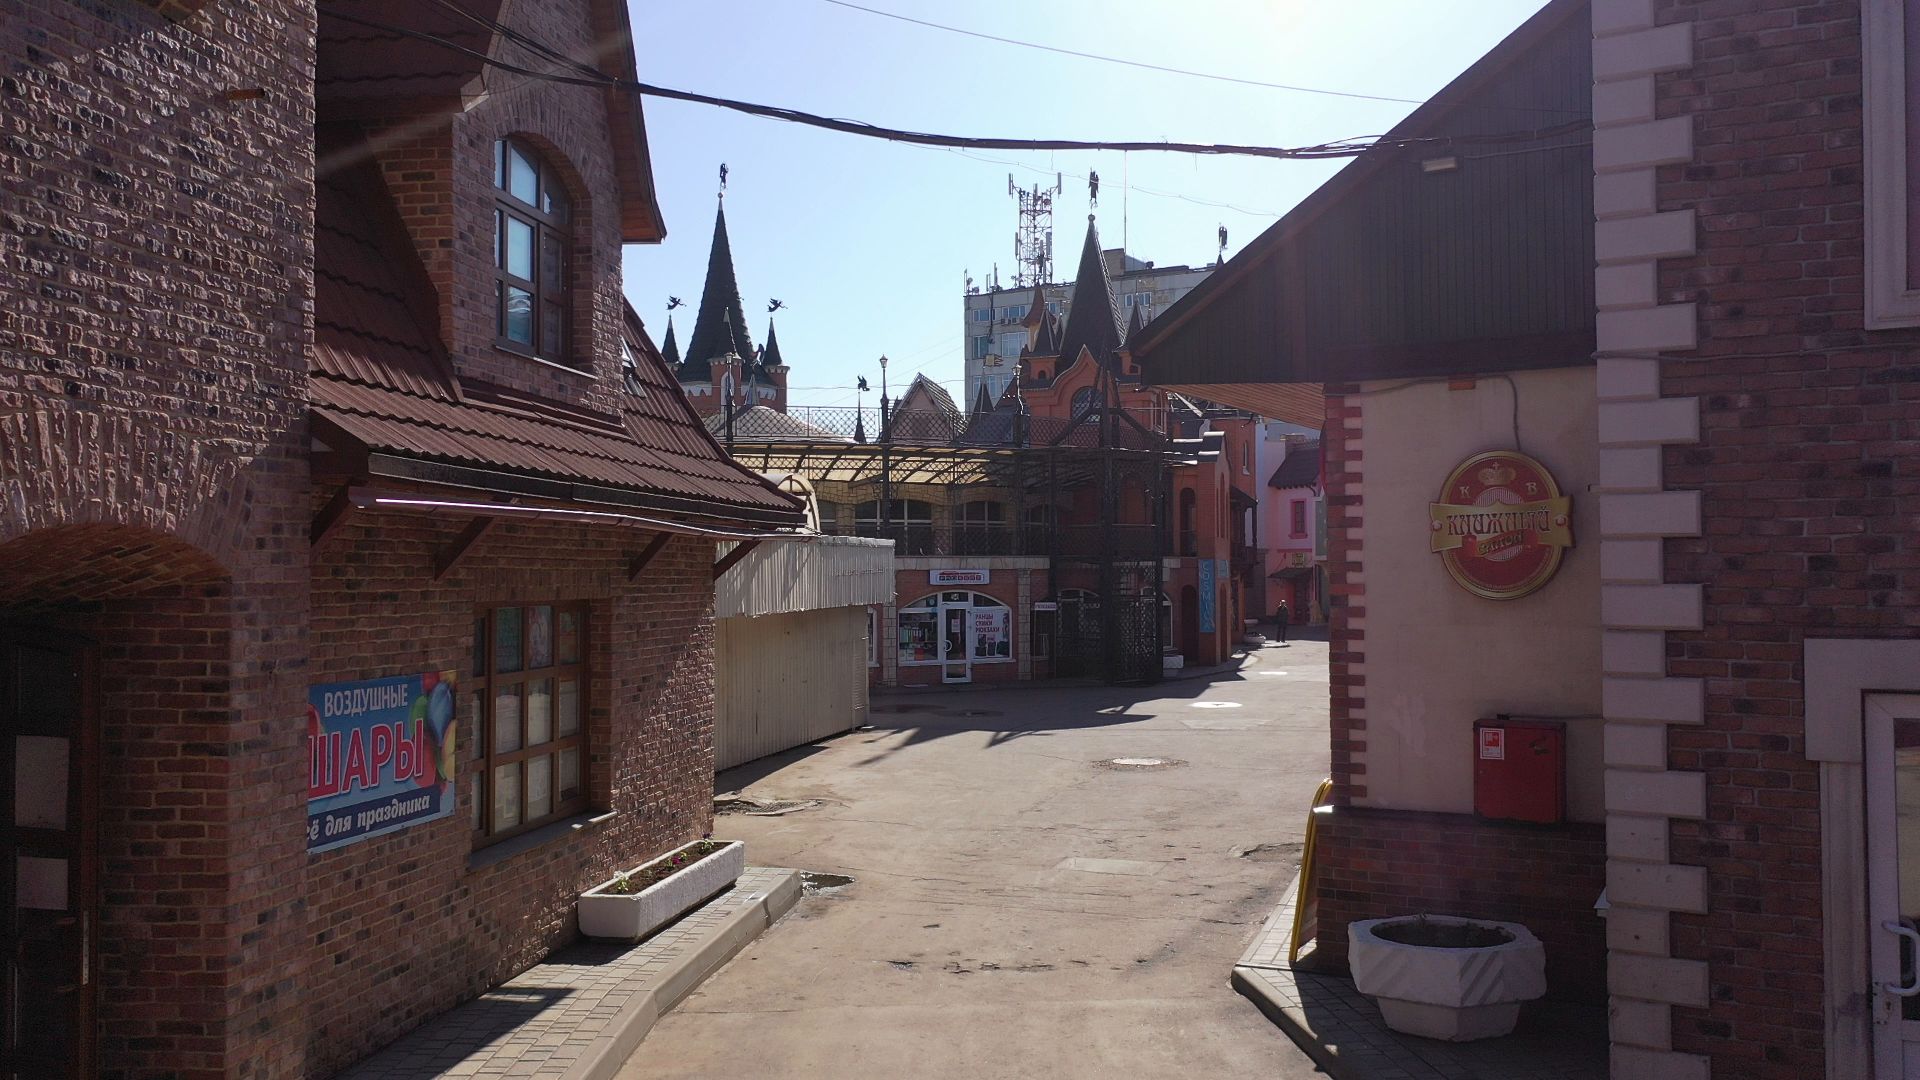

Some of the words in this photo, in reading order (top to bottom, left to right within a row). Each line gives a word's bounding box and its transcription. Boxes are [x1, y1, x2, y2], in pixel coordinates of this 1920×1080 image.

[324, 684, 408, 717] ВОЗДУШНЫЕ
[308, 718, 424, 801] ШАРЫ
[326, 813, 352, 837] для
[357, 794, 431, 830] праздника
